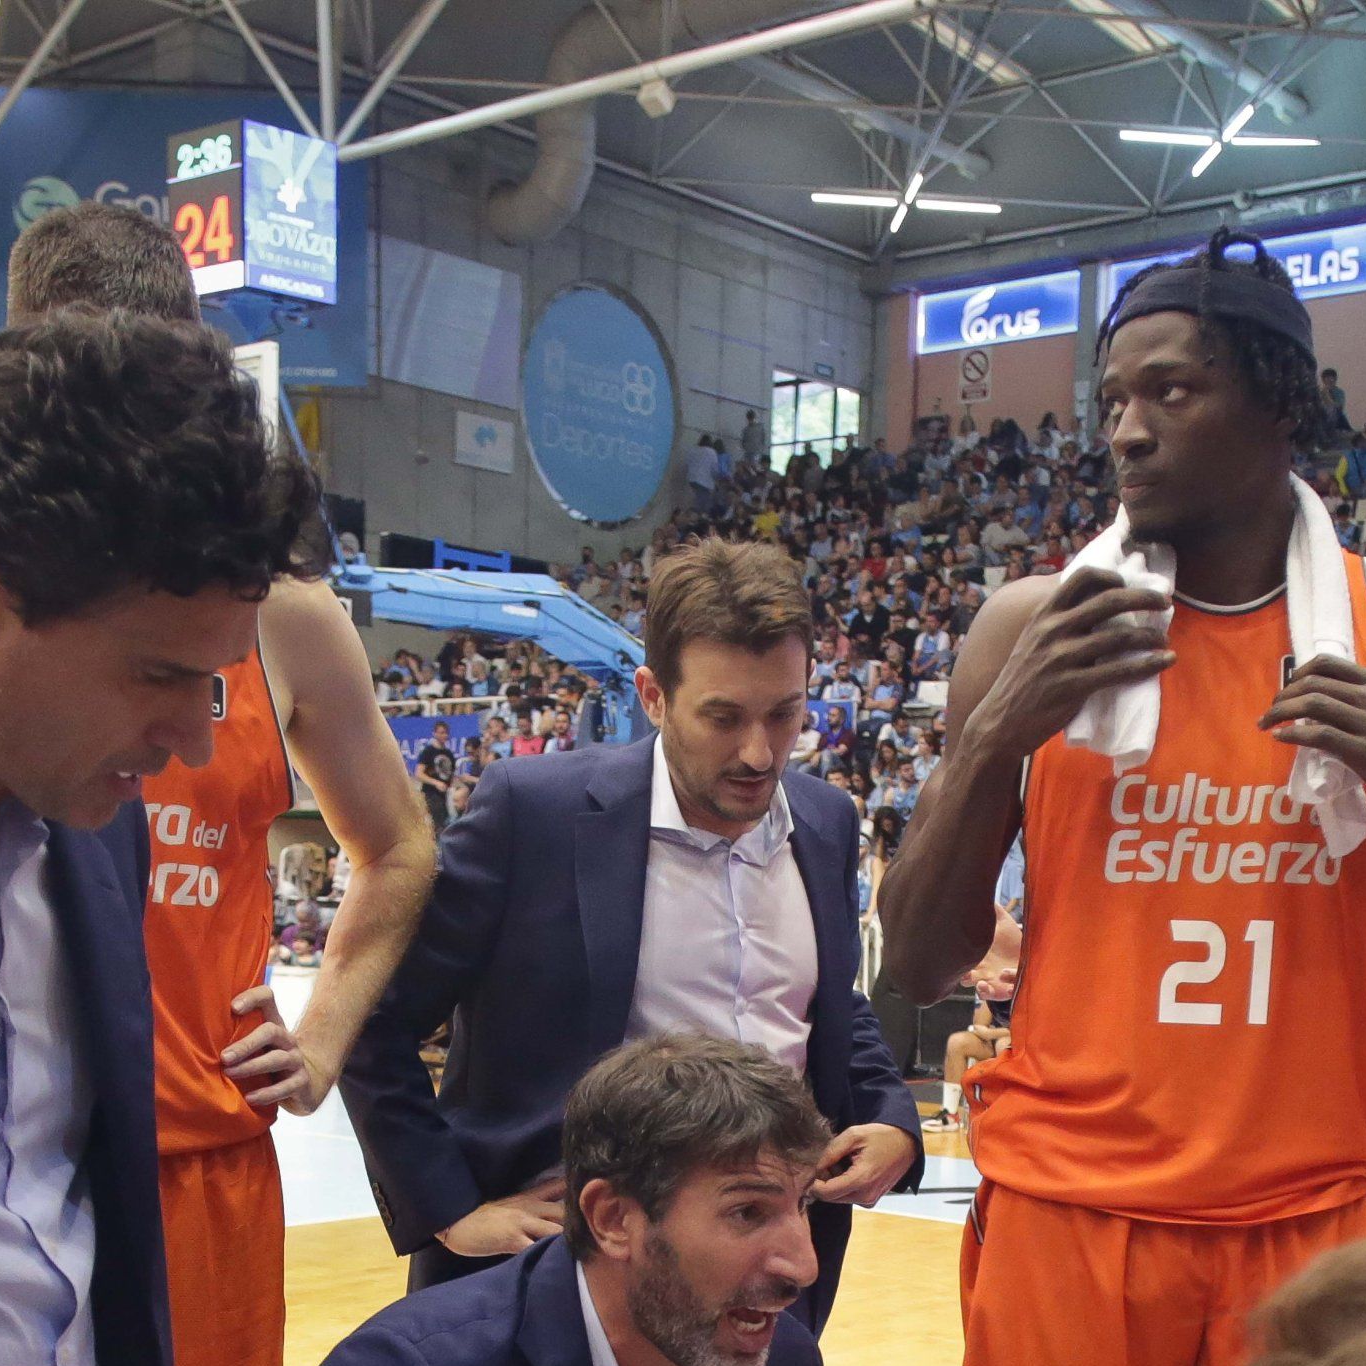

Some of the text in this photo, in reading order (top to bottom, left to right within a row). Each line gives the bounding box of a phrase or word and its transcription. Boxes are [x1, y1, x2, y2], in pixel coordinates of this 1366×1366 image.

[177, 134, 233, 178] 2:36
[174, 195, 236, 267] 24
[1285, 246, 1361, 288] ELAS
[1110, 772, 1303, 825] Cultura
[192, 820, 228, 849] del
[1104, 828, 1342, 885] Esfuerzo
[1158, 919, 1274, 1025] 21
